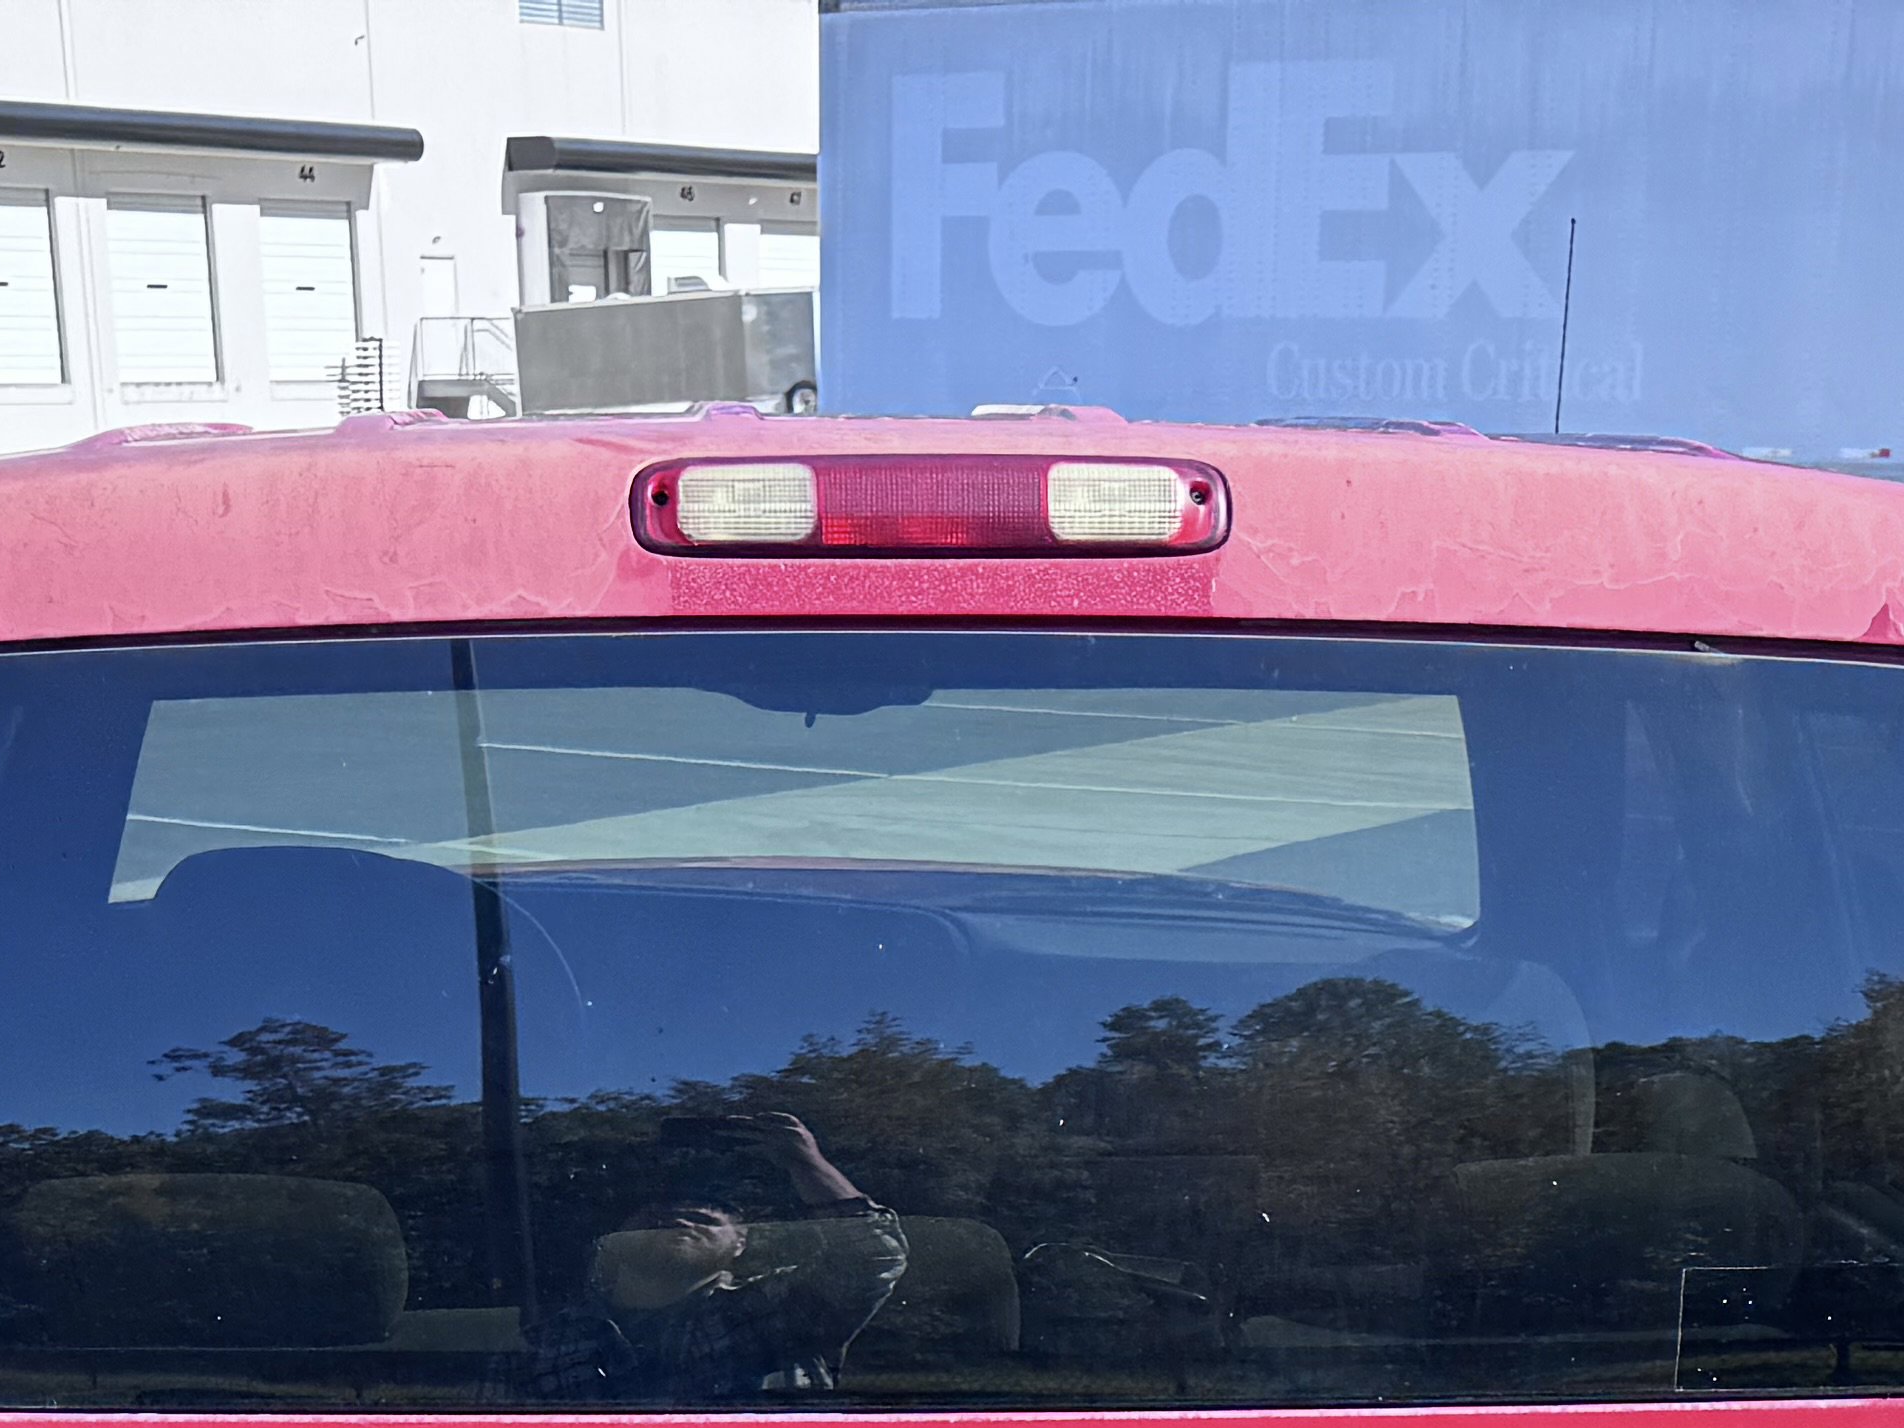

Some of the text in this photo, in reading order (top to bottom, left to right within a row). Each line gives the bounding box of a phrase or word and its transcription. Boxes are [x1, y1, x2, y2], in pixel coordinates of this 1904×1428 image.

[891, 60, 1578, 327] FedEx
[1265, 338, 1644, 403] Custom Critcal
